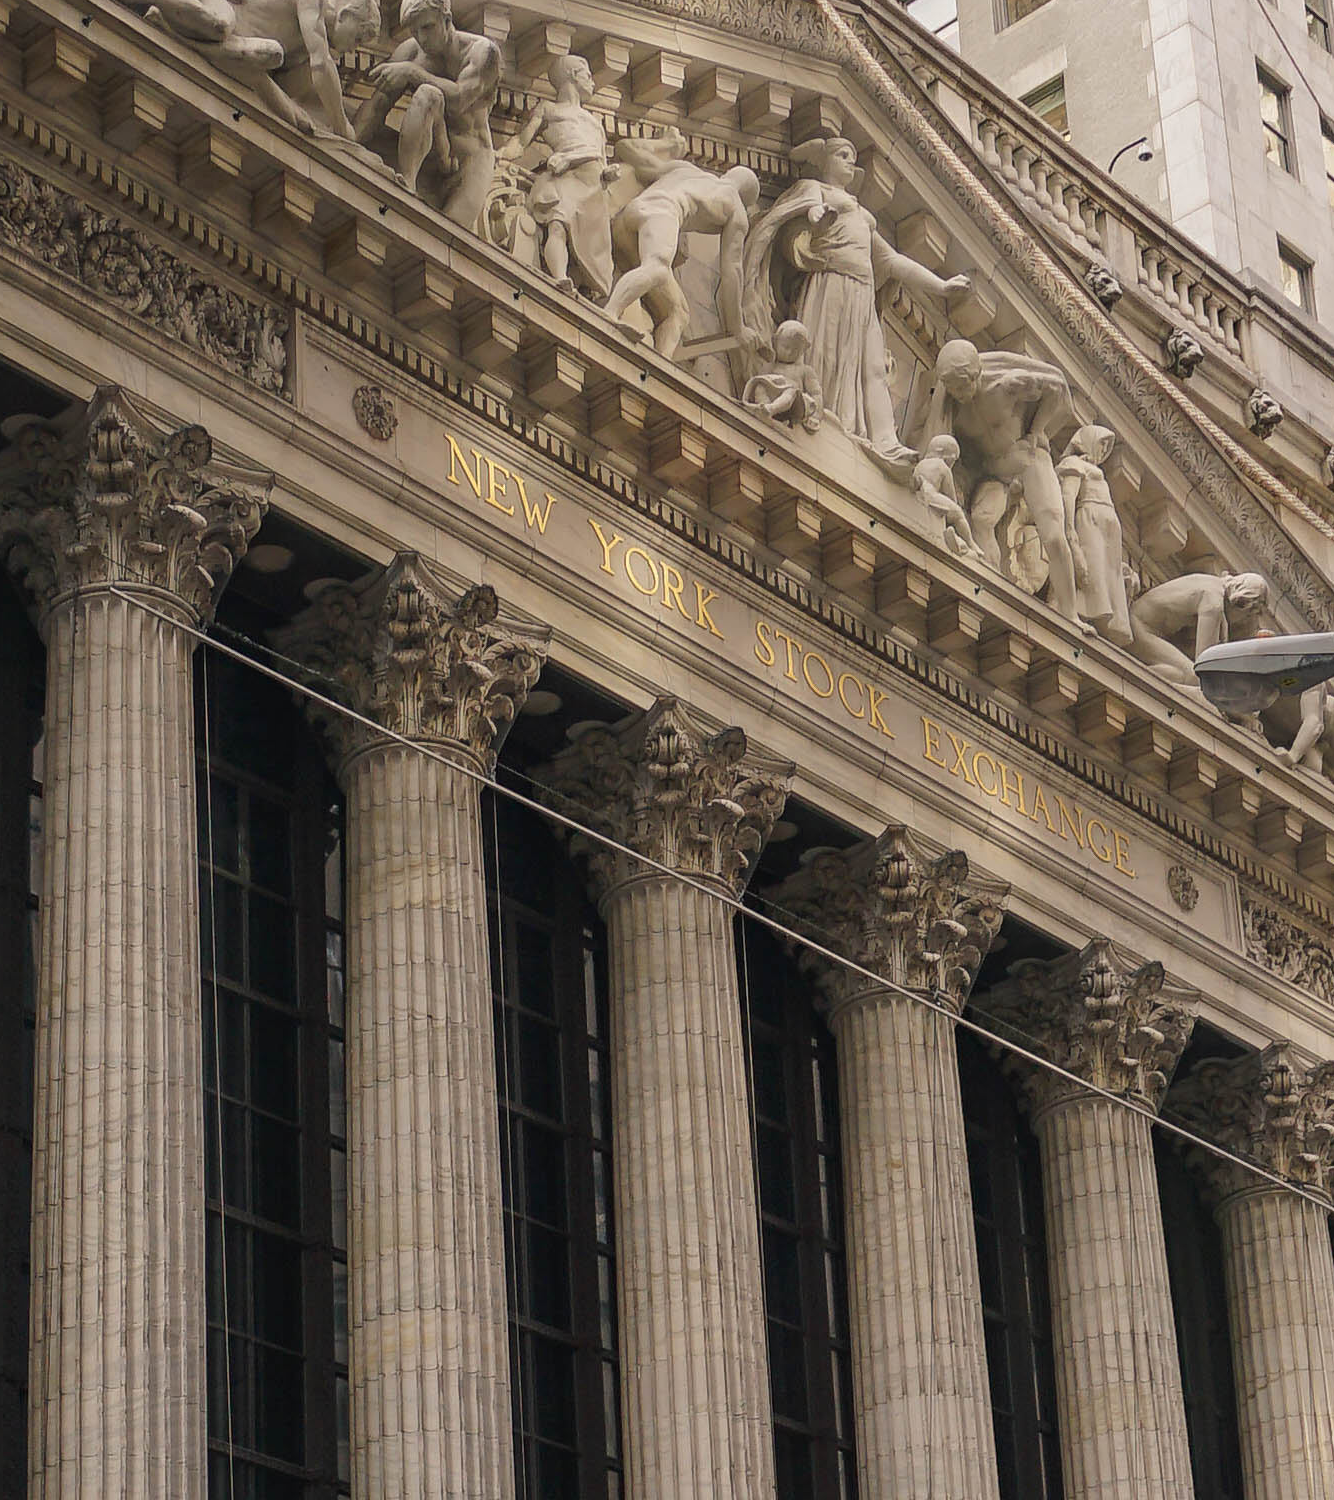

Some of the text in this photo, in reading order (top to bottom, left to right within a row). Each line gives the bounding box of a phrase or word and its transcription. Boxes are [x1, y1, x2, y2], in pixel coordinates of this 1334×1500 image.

[443, 432, 1137, 879] NEW YORK STOCK EXCHANGE
